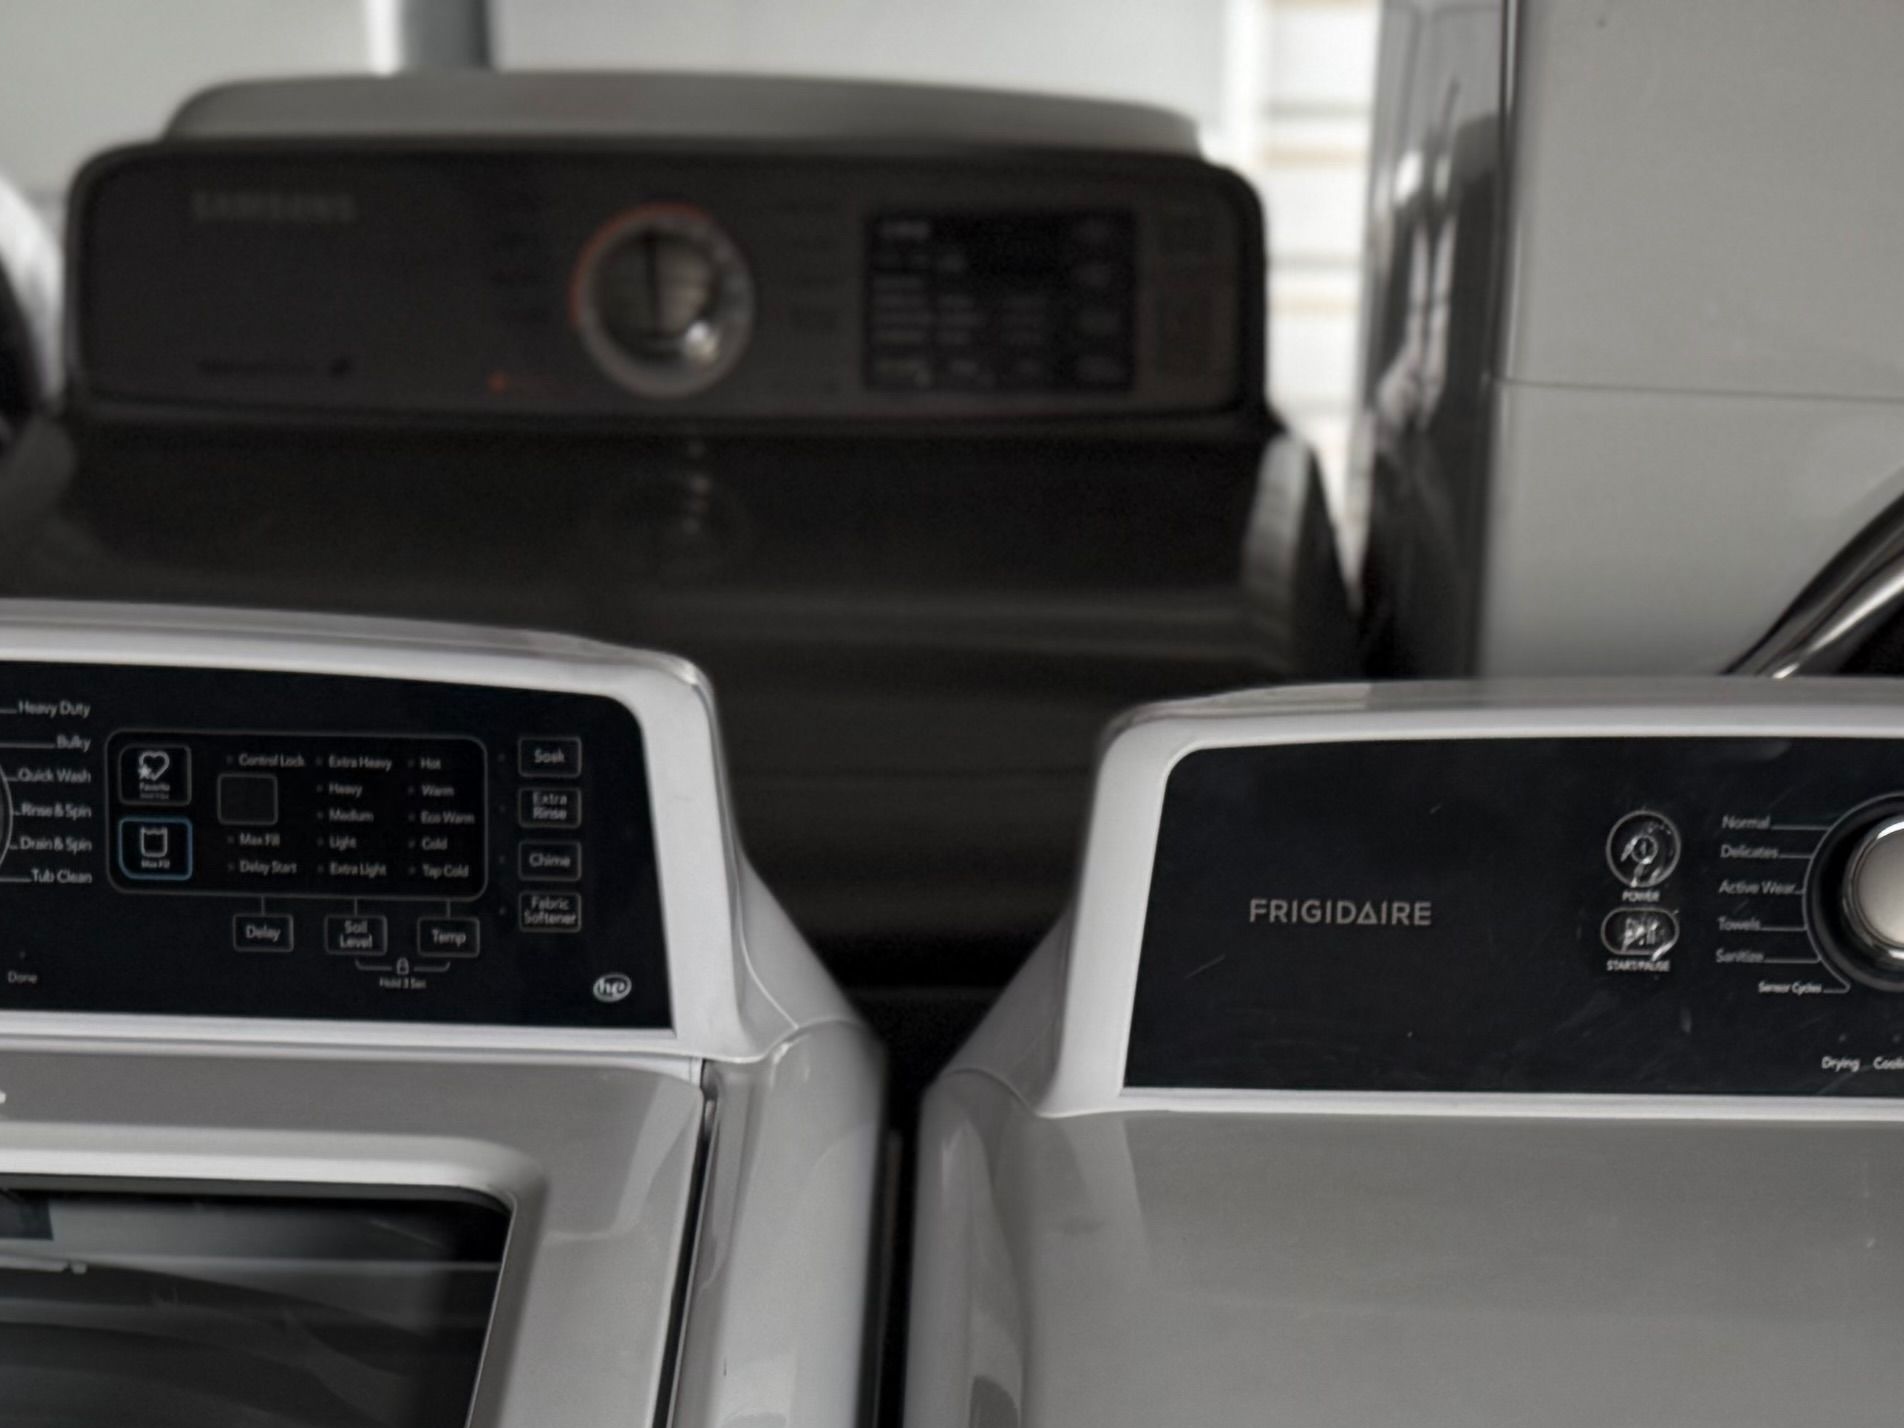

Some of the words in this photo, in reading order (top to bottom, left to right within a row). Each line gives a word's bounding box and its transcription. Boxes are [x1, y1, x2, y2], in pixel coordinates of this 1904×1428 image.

[18, 700, 58, 718] Heavy
[60, 701, 91, 718] Duty
[56, 735, 91, 752] Bulky
[238, 753, 278, 767] Control
[280, 754, 305, 767] Lock
[328, 754, 358, 769] Extra
[359, 755, 392, 772] Heavy
[420, 756, 441, 770] Hot
[534, 749, 565, 764] Soak
[17, 768, 53, 783] Quick
[56, 769, 91, 783] Wash
[328, 783, 362, 798] Heavy
[421, 784, 454, 797] Warm
[532, 791, 567, 806] Extra
[21, 803, 53, 817] Rinse
[54, 804, 64, 817] &
[65, 804, 92, 820] Spin
[329, 809, 374, 823] Medium
[421, 811, 441, 824] Eco
[442, 811, 475, 825] Warm
[532, 805, 567, 820] Rinse
[1721, 816, 1771, 830] Normal
[20, 836, 53, 850] Drain
[54, 837, 64, 851] &
[65, 837, 92, 854] Spin
[239, 833, 263, 846] Max
[264, 833, 280, 846] Fill
[329, 835, 356, 851] Light
[421, 837, 447, 850] Cold
[1720, 844, 1779, 860] Delicates
[239, 860, 270, 876] Delay
[271, 860, 297, 874] Start
[528, 853, 571, 868] Chime
[31, 869, 54, 882] Tub
[57, 869, 92, 883] Clean
[329, 862, 359, 875] Extra
[360, 863, 386, 879] Light
[422, 864, 443, 879] Tap
[444, 865, 469, 878] Cold
[1719, 880, 1759, 894] Active
[1761, 881, 1796, 895] Wear
[531, 896, 569, 911] Fabric
[1622, 890, 1660, 902] POWER
[523, 910, 577, 925] Softener
[1249, 898, 1432, 926] FRIGIDAIRE
[344, 920, 368, 934] Soil
[1717, 917, 1762, 931] Towels
[245, 925, 280, 943] Delay
[340, 933, 373, 949] Level
[432, 929, 466, 947] Temp
[1716, 949, 1765, 963] Sanitize
[7, 970, 38, 984] Done
[1758, 981, 1790, 993] Sensor
[1791, 981, 1822, 995] Cycles
[1821, 1056, 1861, 1072] Drying
